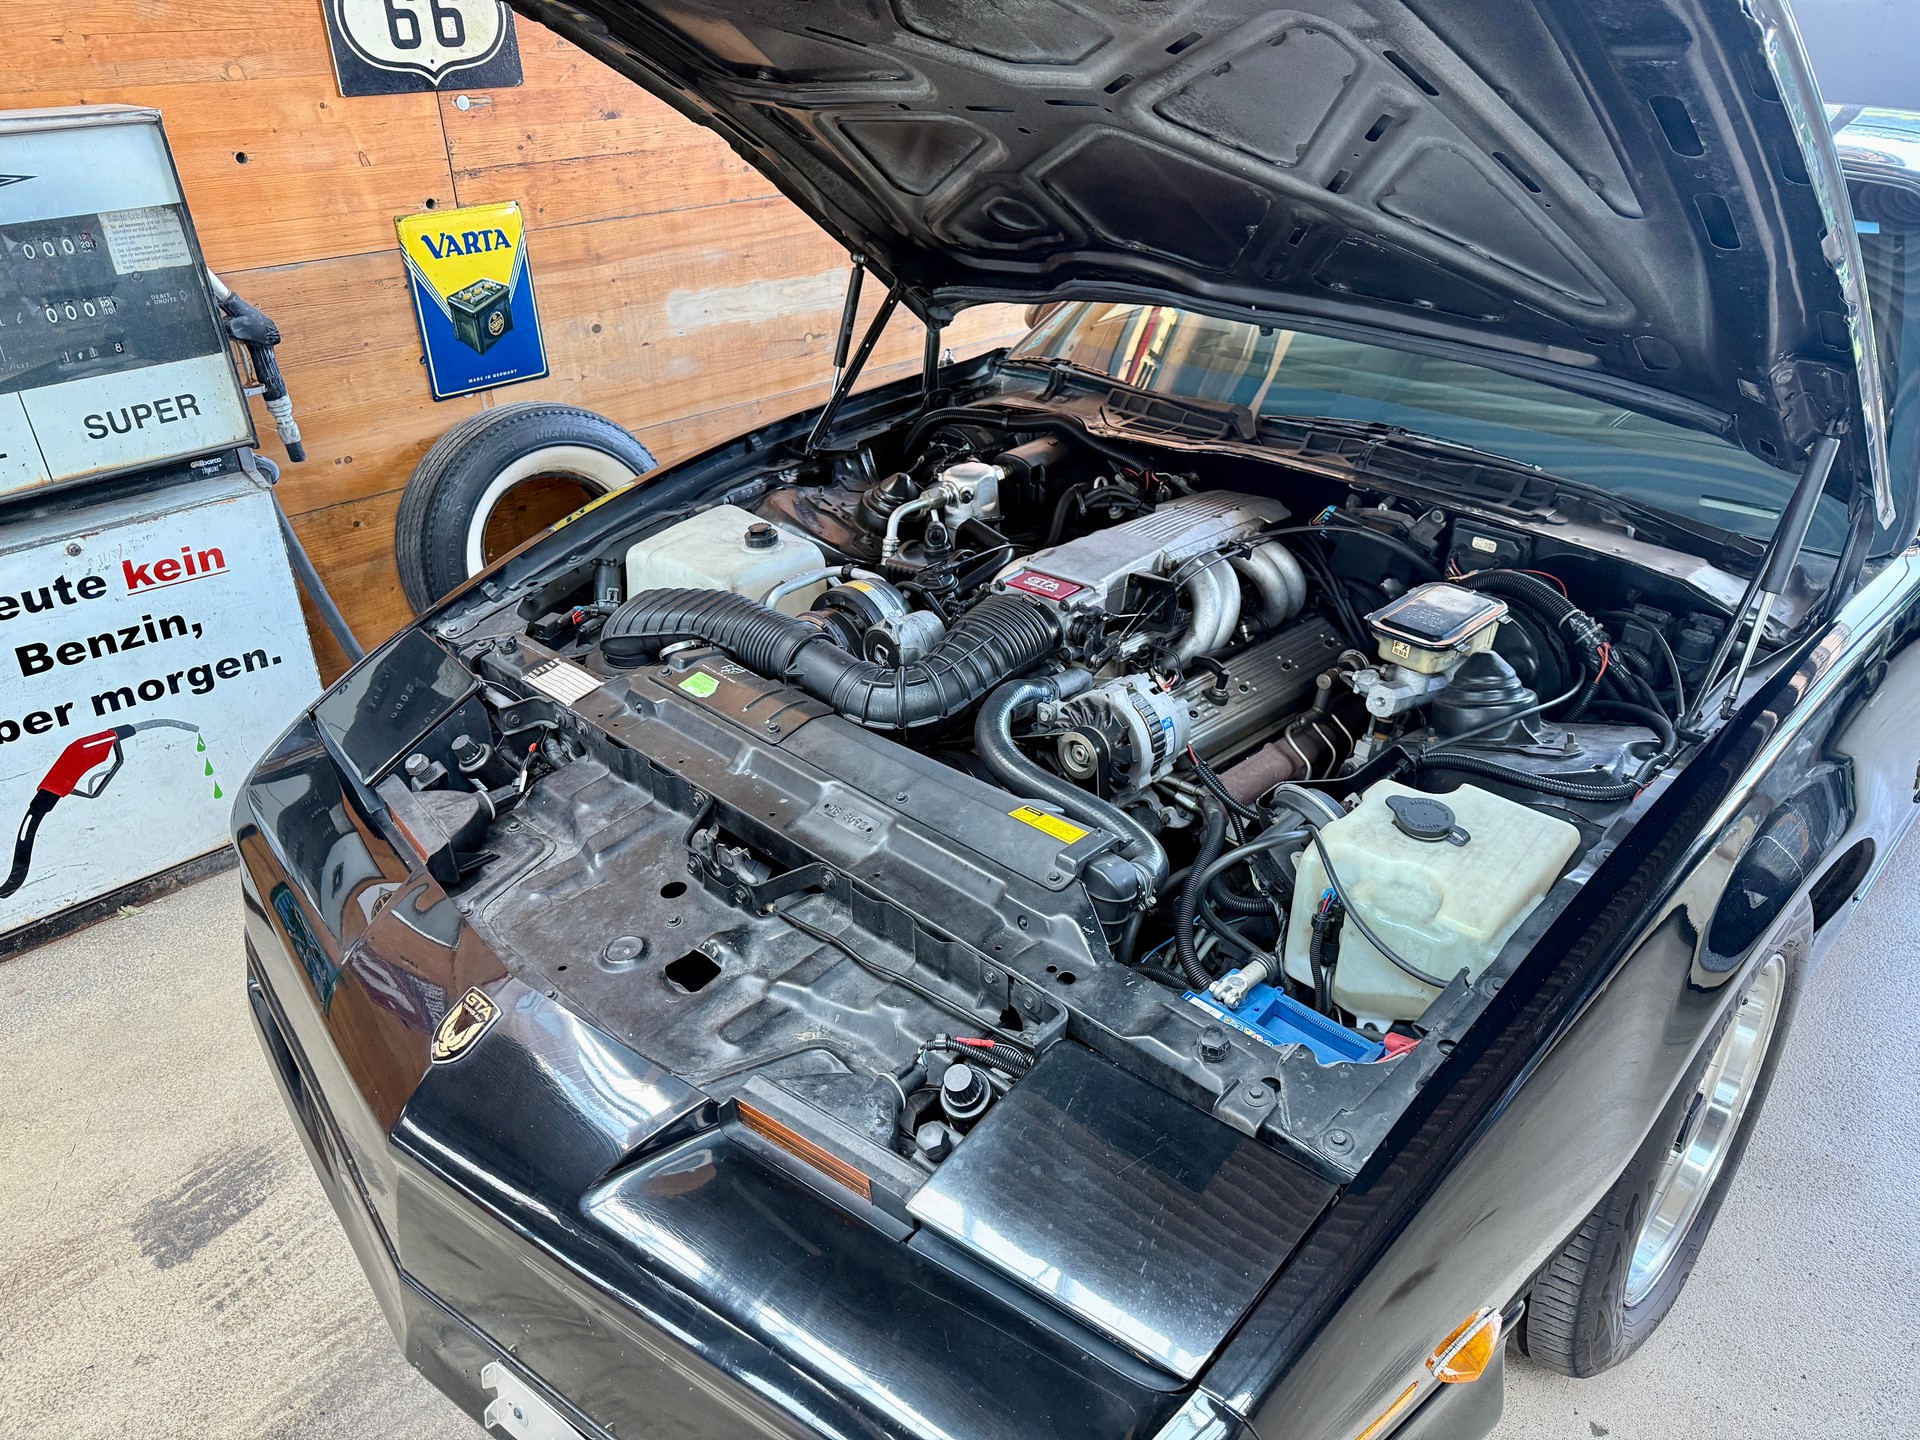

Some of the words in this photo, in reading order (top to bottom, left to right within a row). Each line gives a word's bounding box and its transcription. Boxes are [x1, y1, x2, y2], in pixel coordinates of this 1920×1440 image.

[383, 0, 466, 50] 66
[420, 228, 512, 260] VARTA
[493, 368, 518, 378] GERMANY
[83, 393, 202, 440] SUPER
[0, 574, 108, 621] eute
[121, 545, 226, 591] kein
[14, 613, 204, 678] Benzin,
[90, 648, 282, 717] morgen.
[465, 992, 492, 1022] GTA
